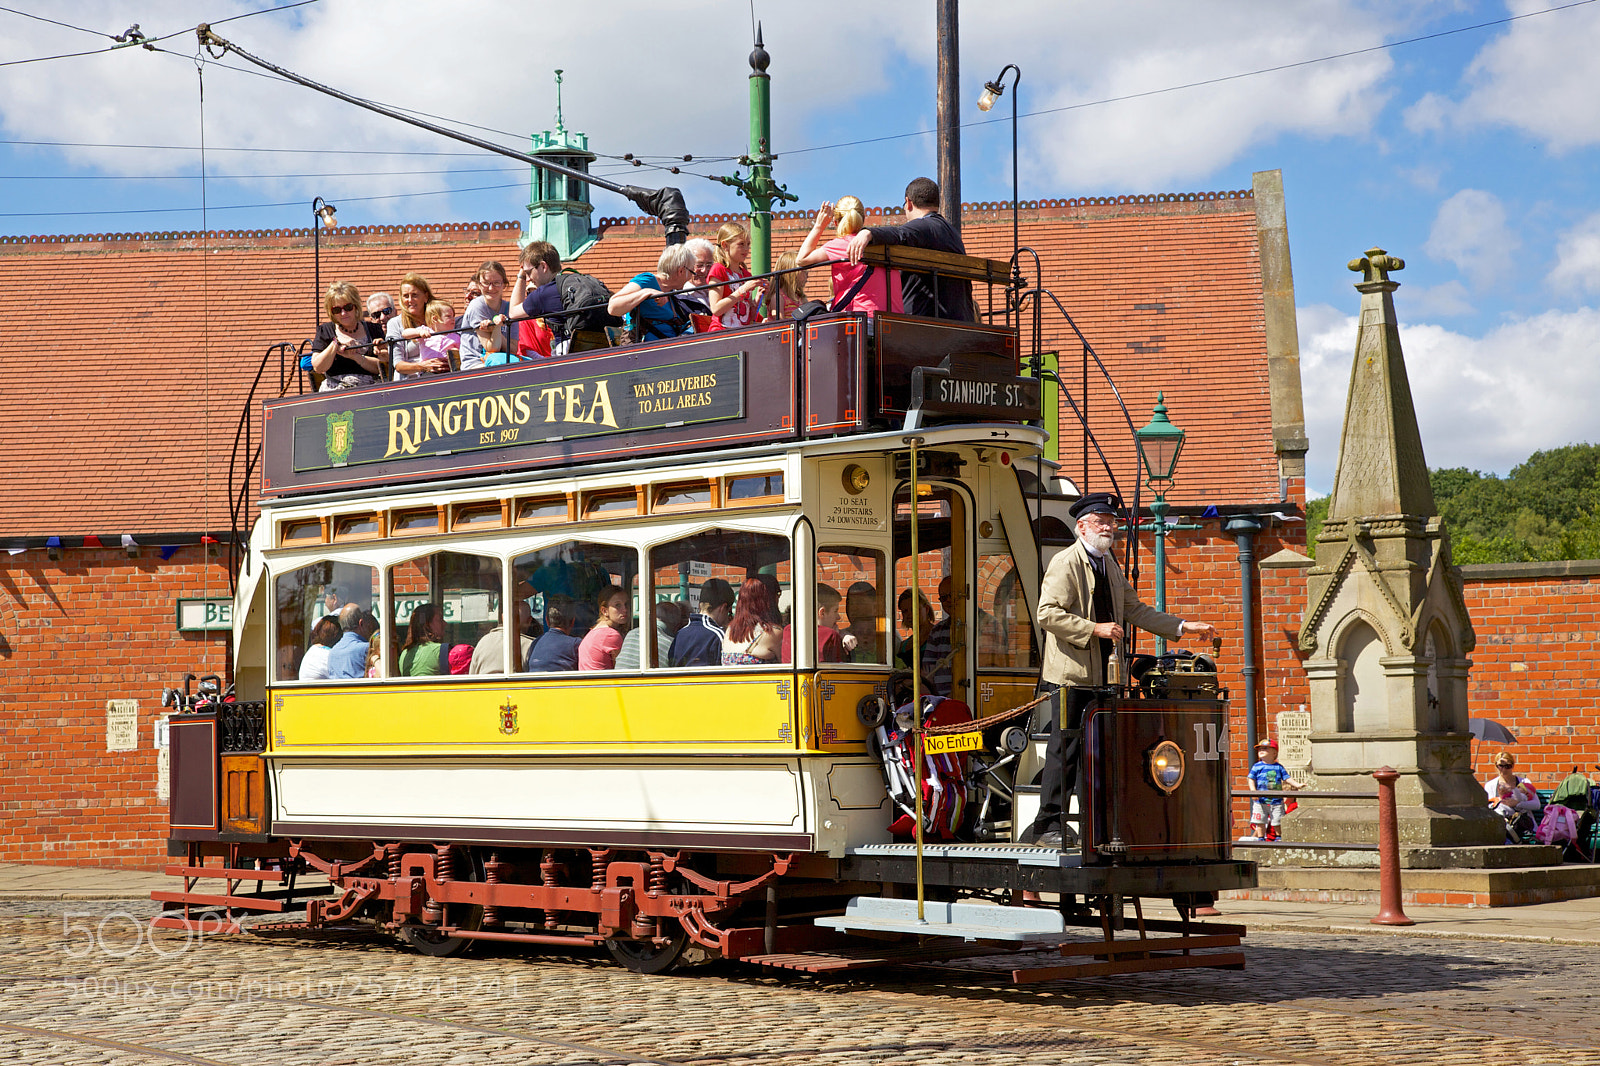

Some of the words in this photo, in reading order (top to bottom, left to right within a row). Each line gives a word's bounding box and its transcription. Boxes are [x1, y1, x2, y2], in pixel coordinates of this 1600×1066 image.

[633, 382, 655, 398] VAN
[656, 373, 717, 395] DELIVERIES
[940, 379, 998, 406] STANHOPE
[1005, 384, 1023, 407] ST.
[638, 400, 652, 414] TO
[653, 397, 675, 413] ALL
[676, 391, 712, 409] AREAS
[383, 390, 531, 459] RINGTONS
[538, 379, 620, 429] TEA
[479, 431, 496, 445] EST.
[500, 427, 520, 443] 1907
[833, 506, 842, 515] 29
[843, 507, 873, 516] UPSTAIRS
[839, 497, 849, 506] TO
[850, 498, 868, 506] SEAT
[827, 515, 835, 523] 24
[837, 516, 879, 525] DOWNSTAIRS
[203, 602, 232, 623] BE
[927, 738, 944, 751] No
[946, 735, 979, 749] Entry
[1193, 723, 1229, 760] 114
[1338, 822, 1380, 833] NEWCAST
